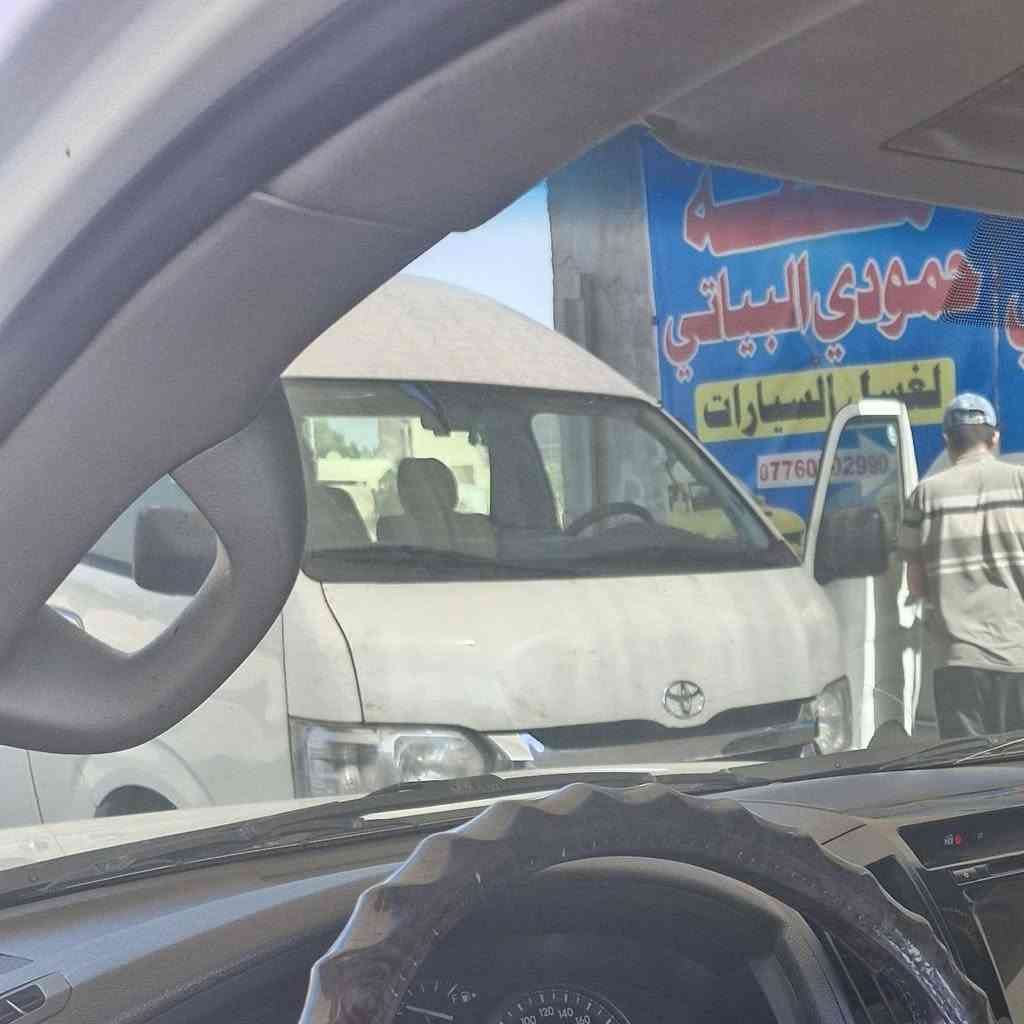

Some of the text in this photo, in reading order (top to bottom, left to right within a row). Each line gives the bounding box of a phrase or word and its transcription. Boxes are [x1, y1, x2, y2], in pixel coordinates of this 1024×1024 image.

[663, 250, 812, 382] البياتي
[702, 372, 836, 438] السيارات
[758, 454, 889, 482] 0776002990
[538, 1006, 556, 1017] 120
[558, 1006, 574, 1018] 140
